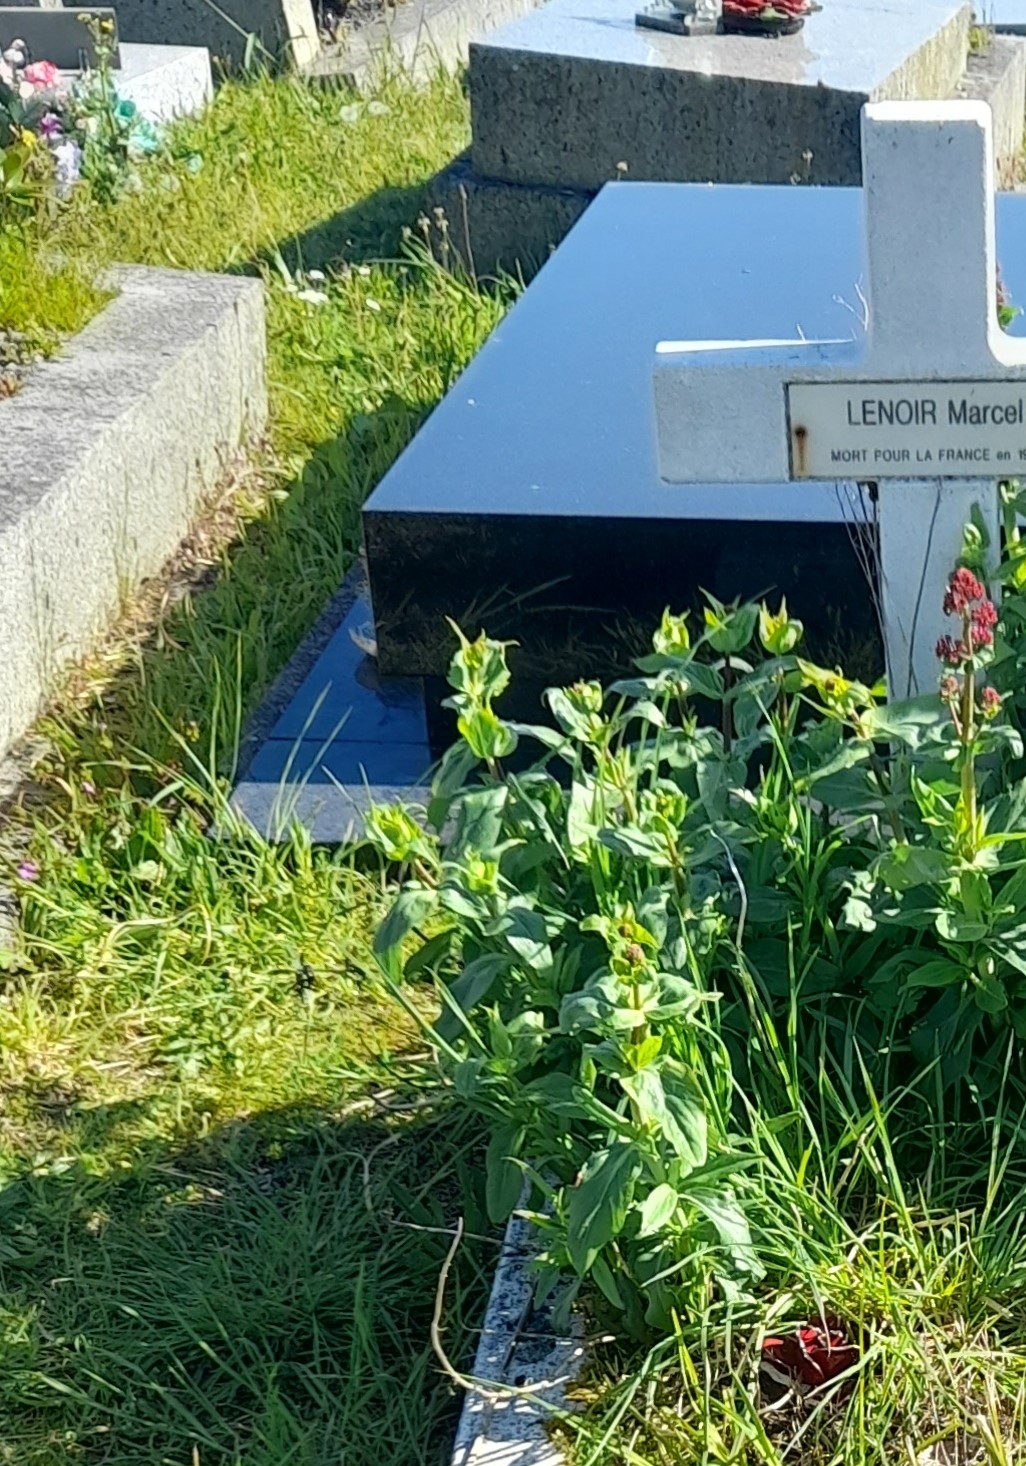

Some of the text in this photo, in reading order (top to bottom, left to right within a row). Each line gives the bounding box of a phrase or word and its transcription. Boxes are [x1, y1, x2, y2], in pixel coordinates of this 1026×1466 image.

[847, 399, 1024, 425] LENOIR Marcel
[830, 449, 867, 462] MORT
[874, 449, 910, 462] POUR
[916, 449, 932, 461] LA
[939, 448, 990, 461] FRANCE
[996, 452, 1011, 461] en
